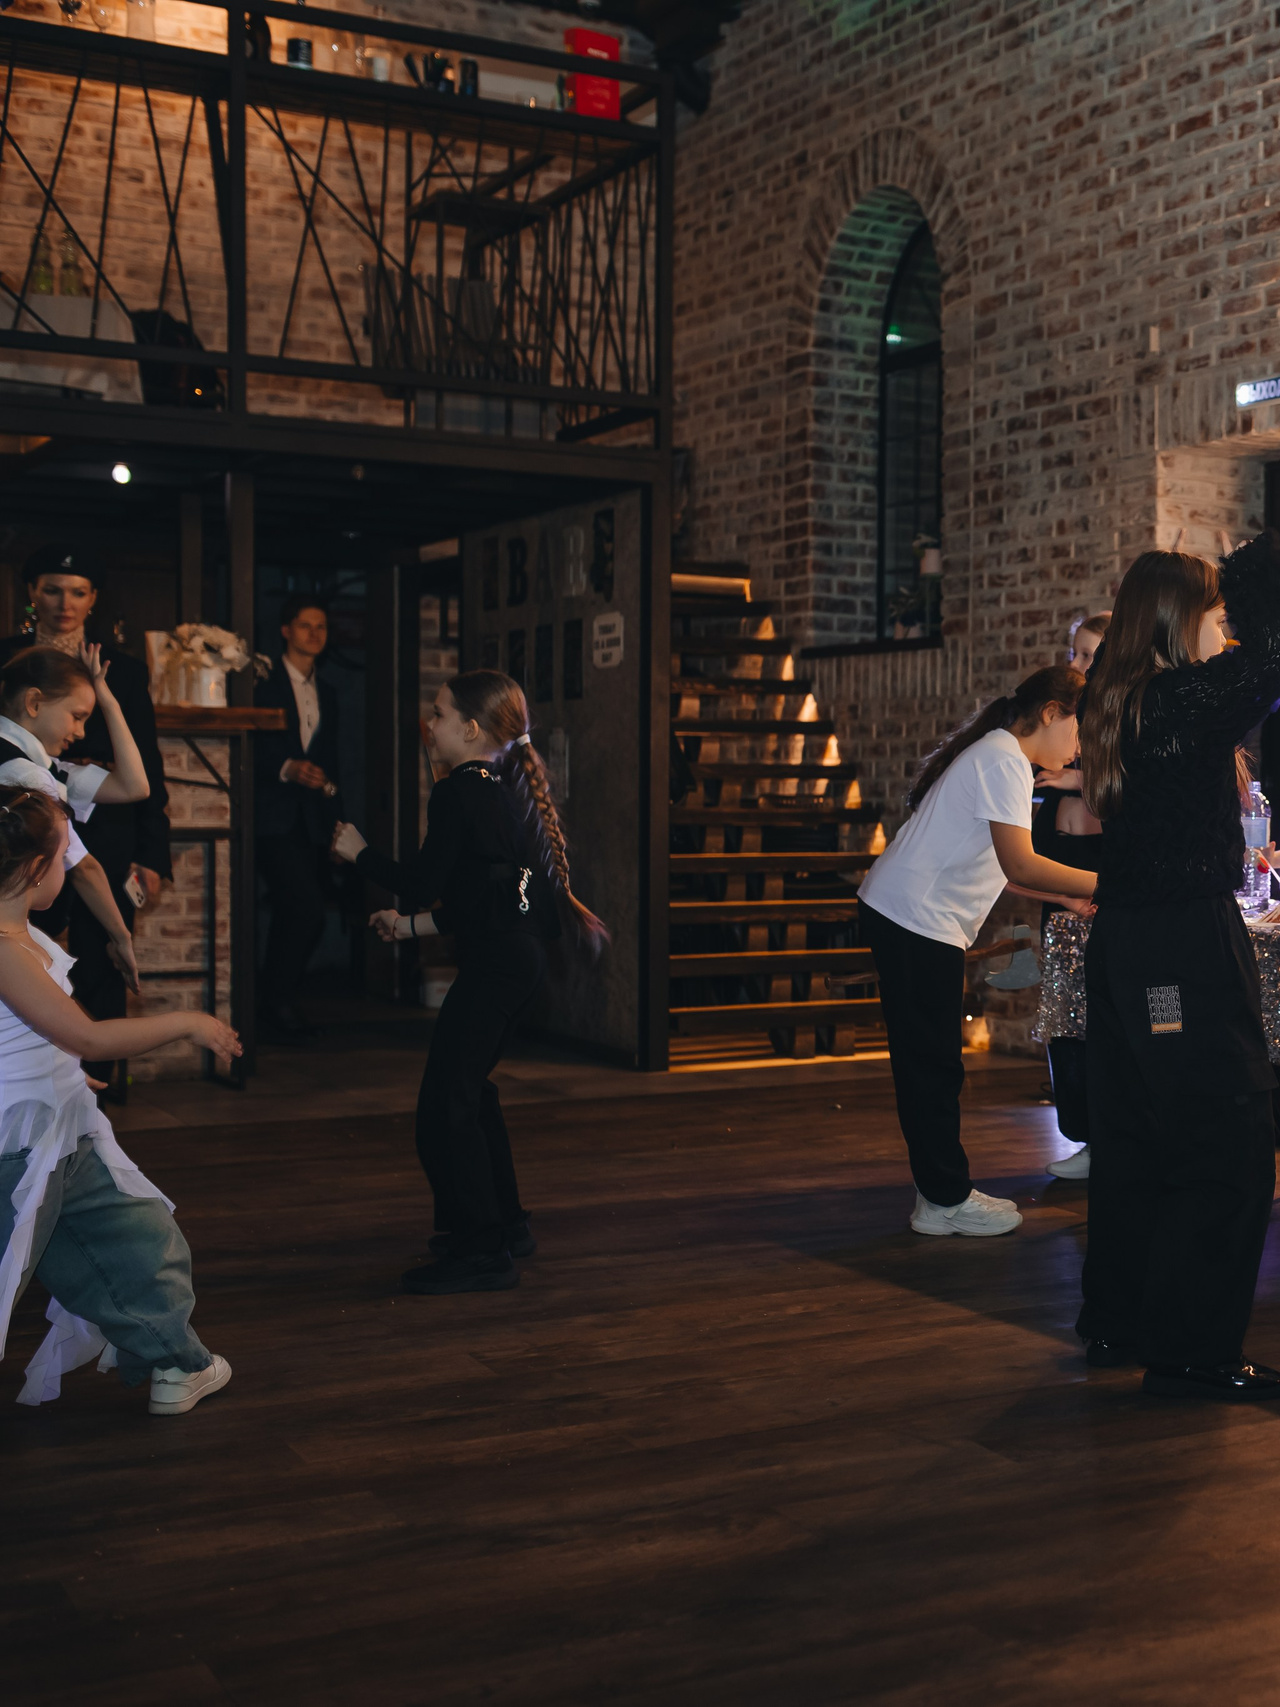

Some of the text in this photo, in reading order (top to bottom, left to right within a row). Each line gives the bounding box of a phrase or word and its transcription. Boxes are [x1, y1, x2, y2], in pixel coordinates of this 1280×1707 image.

[1146, 985, 1179, 997] LONDON
[1148, 995, 1180, 1006] LONDON
[1149, 1004, 1181, 1015] LONDON
[1150, 1013, 1182, 1024] LONDON
